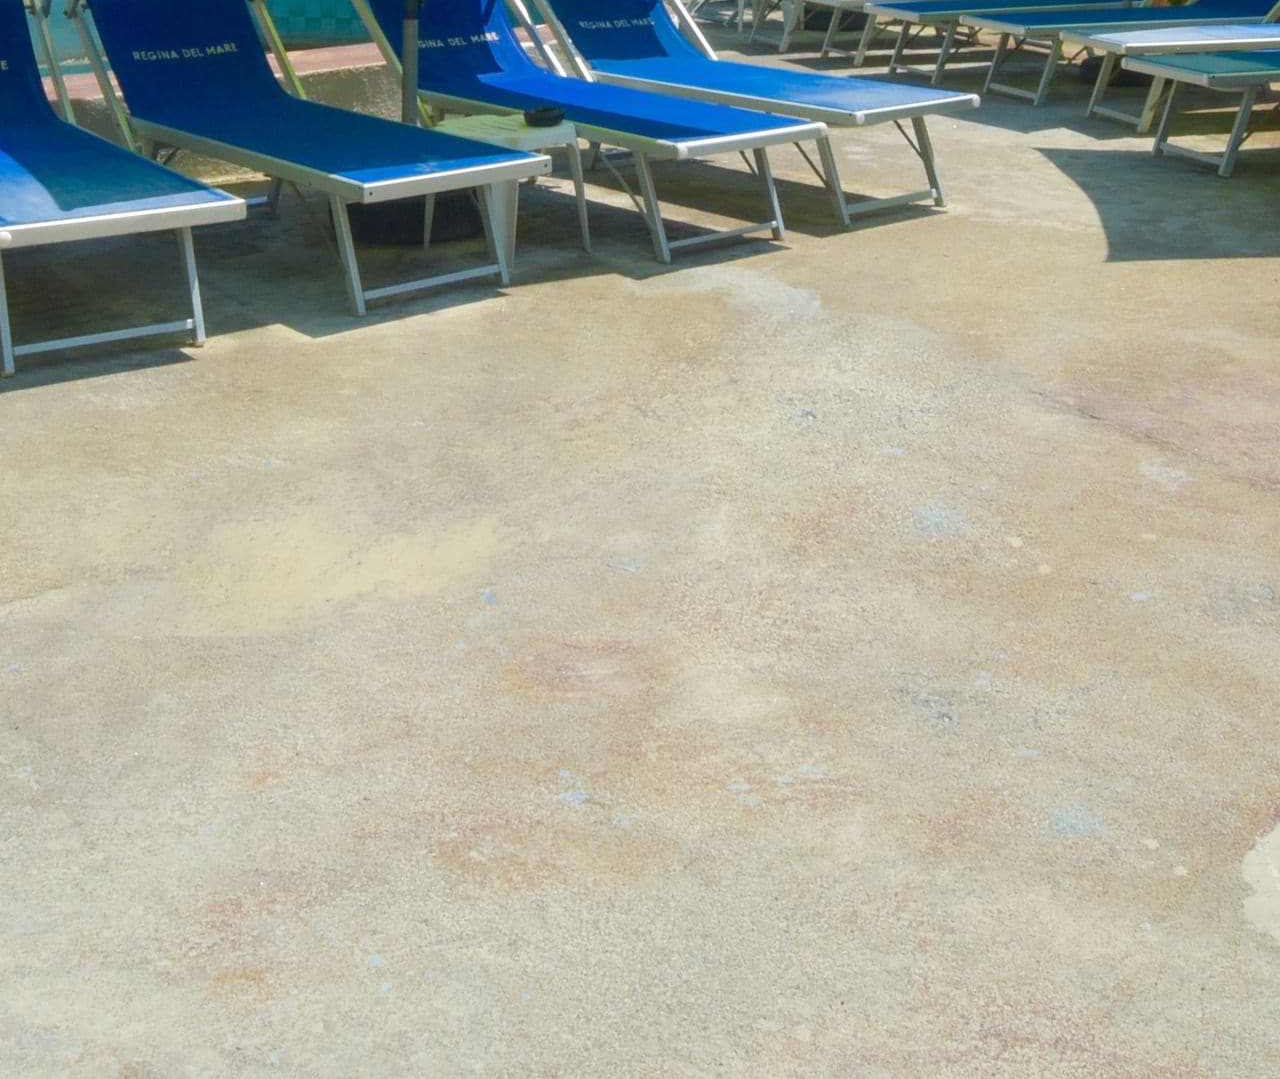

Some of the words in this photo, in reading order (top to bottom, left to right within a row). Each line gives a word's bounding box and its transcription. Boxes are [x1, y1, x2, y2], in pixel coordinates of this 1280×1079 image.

[579, 20, 613, 29] REGINA
[614, 19, 631, 28] DEL
[631, 17, 655, 26] MARE
[417, 39, 444, 49] GINA
[447, 36, 468, 46] DEL
[470, 32, 499, 43] MARE
[132, 49, 180, 61] REGINA
[182, 47, 204, 58] DEL
[206, 42, 238, 55] MARE
